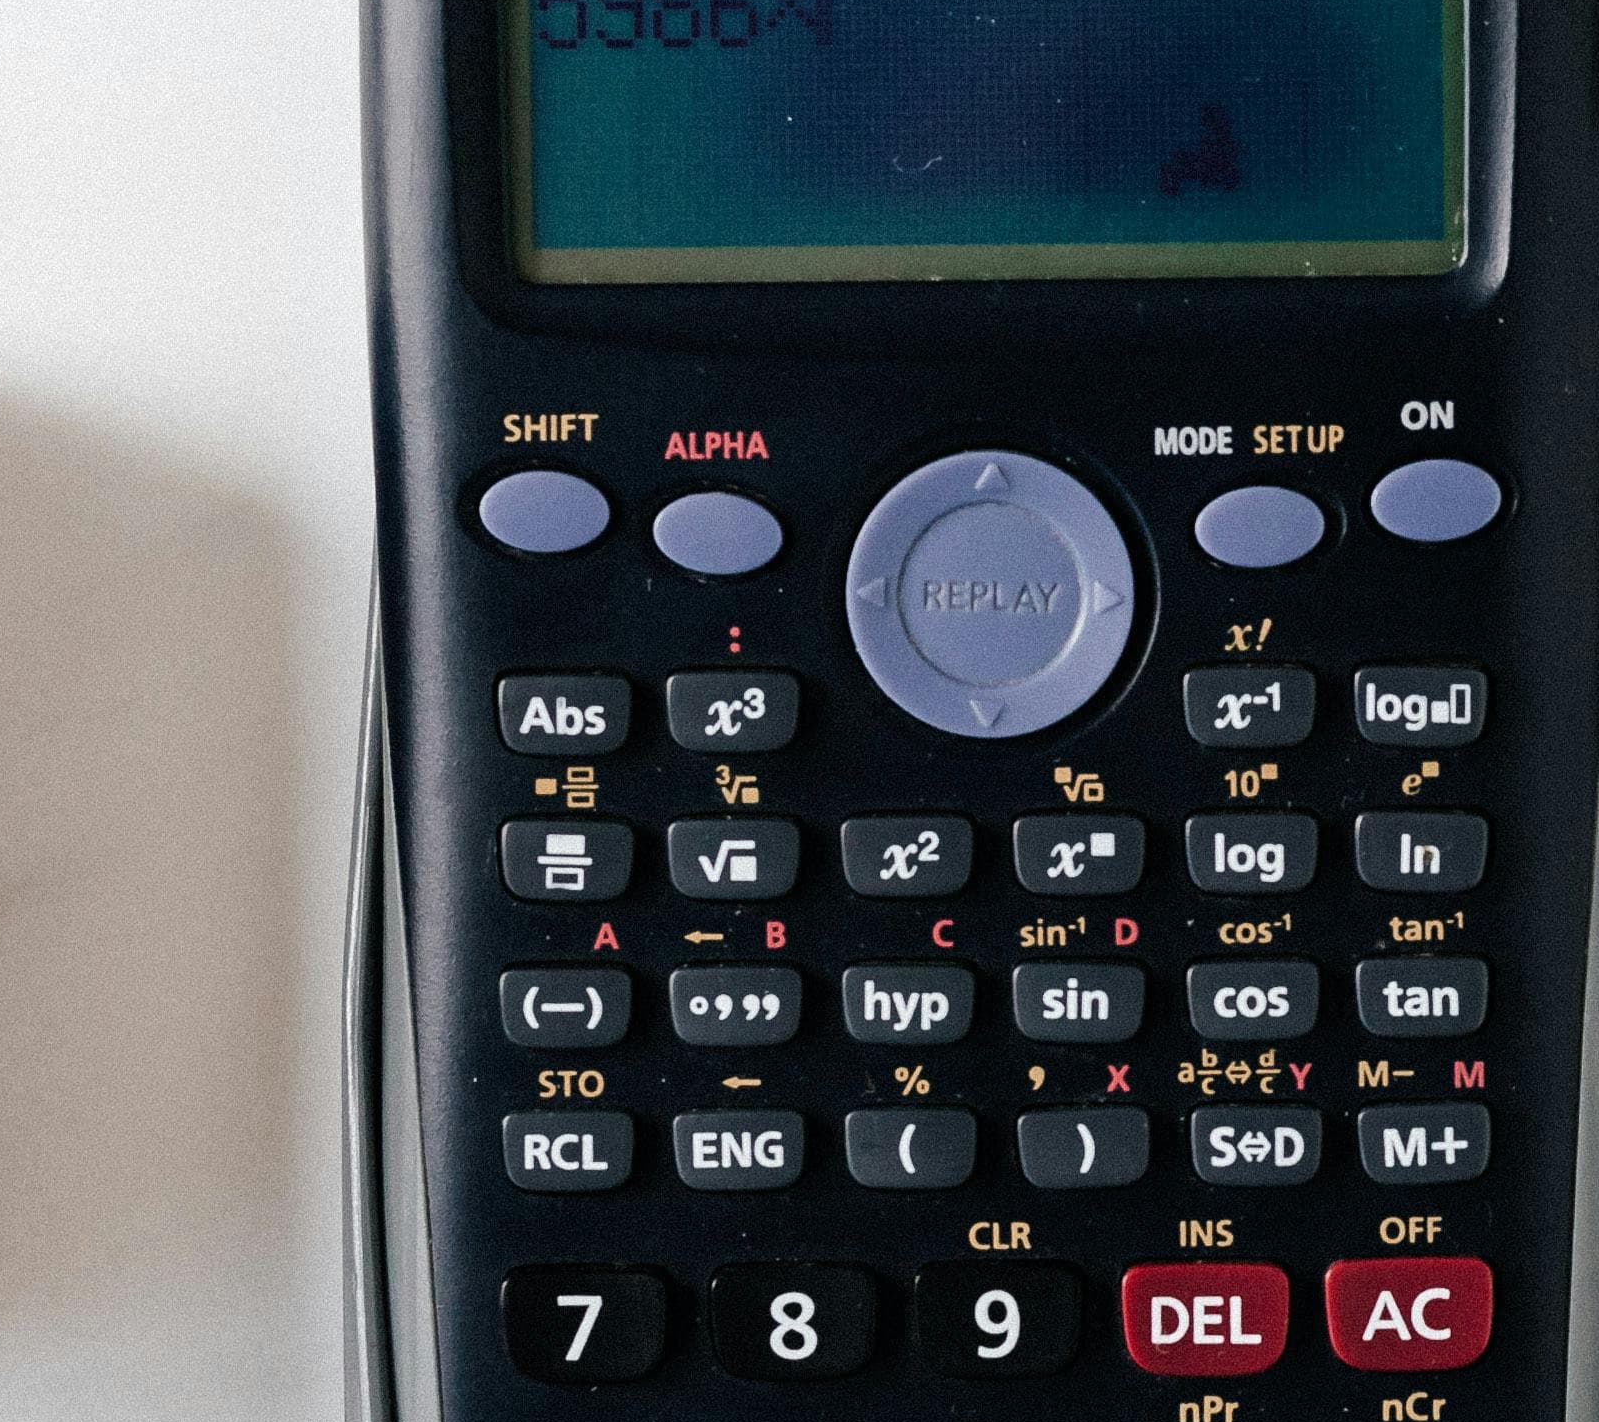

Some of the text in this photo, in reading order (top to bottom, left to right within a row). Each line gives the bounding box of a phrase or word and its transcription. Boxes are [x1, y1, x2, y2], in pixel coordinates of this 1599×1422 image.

[504, 414, 598, 442] SHIFT
[1401, 401, 1454, 430] ON
[665, 432, 768, 459] ALPHA
[1155, 426, 1233, 455] MODE
[923, 581, 1059, 614] REPLAY
[520, 697, 605, 735] Abs
[1215, 833, 1284, 882] log
[1401, 834, 1440, 874] ln
[594, 923, 619, 949] A
[766, 921, 785, 948] B
[933, 919, 953, 947] C
[1115, 918, 1138, 945] D
[865, 980, 948, 1031] hyp
[1043, 978, 1108, 1019] sin
[1214, 987, 1289, 1018] cos
[1383, 981, 1459, 1016] tan
[539, 1071, 604, 1097] STO
[895, 1066, 930, 1095] %
[1108, 1065, 1130, 1092] X
[1290, 1063, 1311, 1090] Y
[1454, 1061, 1484, 1088] M
[524, 1134, 608, 1170] RCL
[693, 1131, 783, 1168] ENG
[1384, 1127, 1468, 1167] M+
[969, 1222, 1031, 1250] CLR
[1180, 1220, 1233, 1247] INS
[1380, 1217, 1442, 1244] OFF
[557, 1295, 602, 1361] 7
[770, 1292, 817, 1360] 8
[975, 1290, 1020, 1358] 9
[1151, 1296, 1262, 1344] DEL
[1363, 1288, 1451, 1341] AC
[1383, 1392, 1446, 1421] nCr
